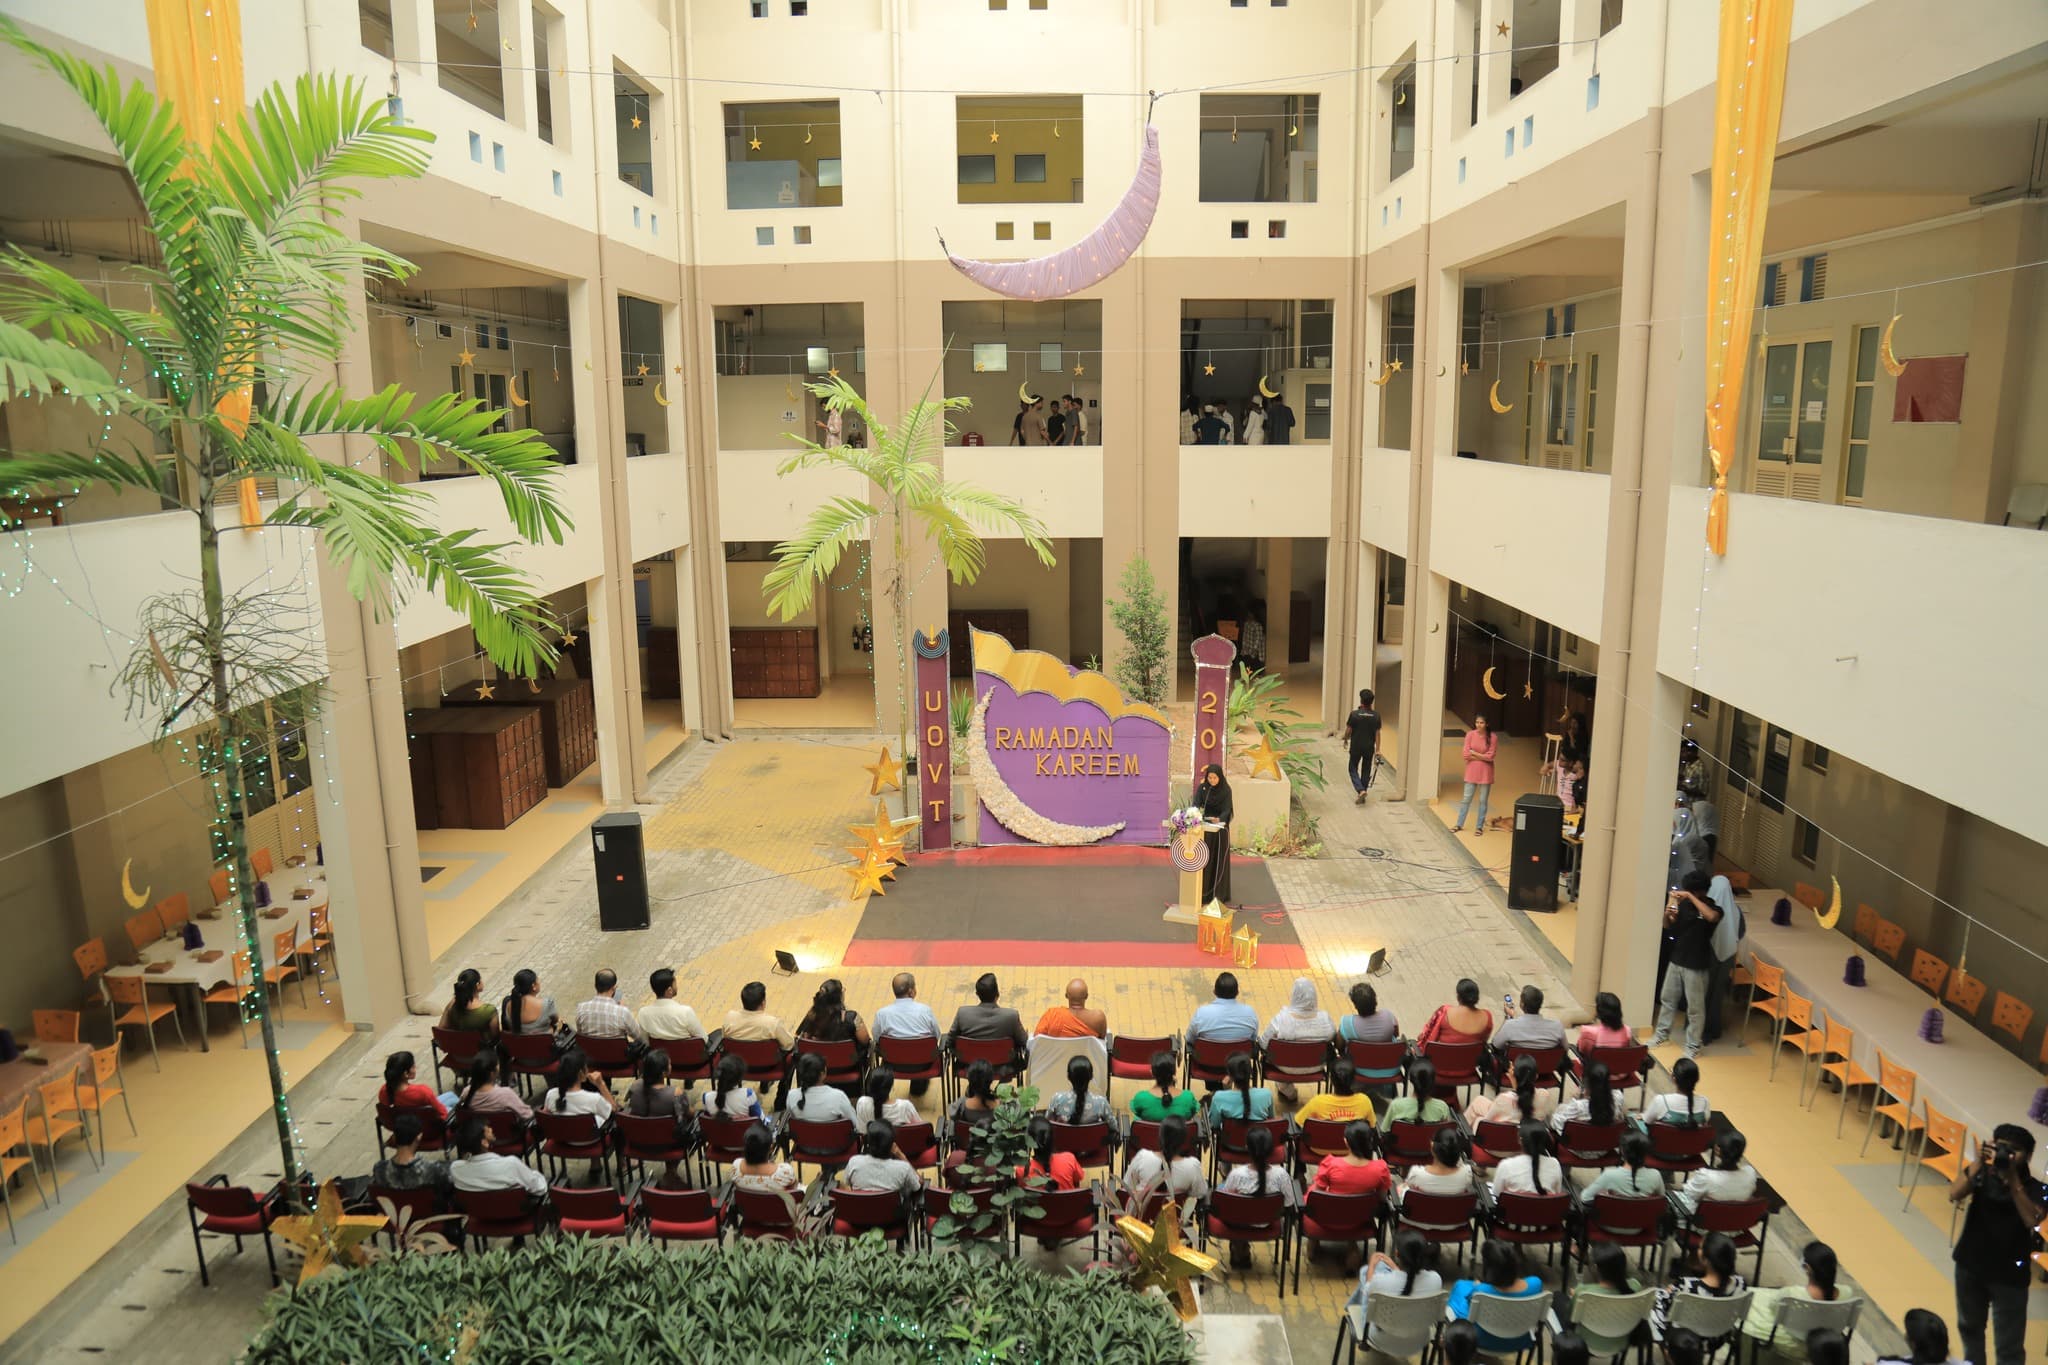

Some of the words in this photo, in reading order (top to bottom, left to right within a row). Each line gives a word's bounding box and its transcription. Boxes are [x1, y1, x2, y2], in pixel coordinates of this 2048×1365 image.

[925, 690, 945, 822] UOVT
[995, 726, 1114, 749] RAMADAN
[1035, 753, 1140, 776] KAREEM
[1201, 691, 1217, 784] 20
